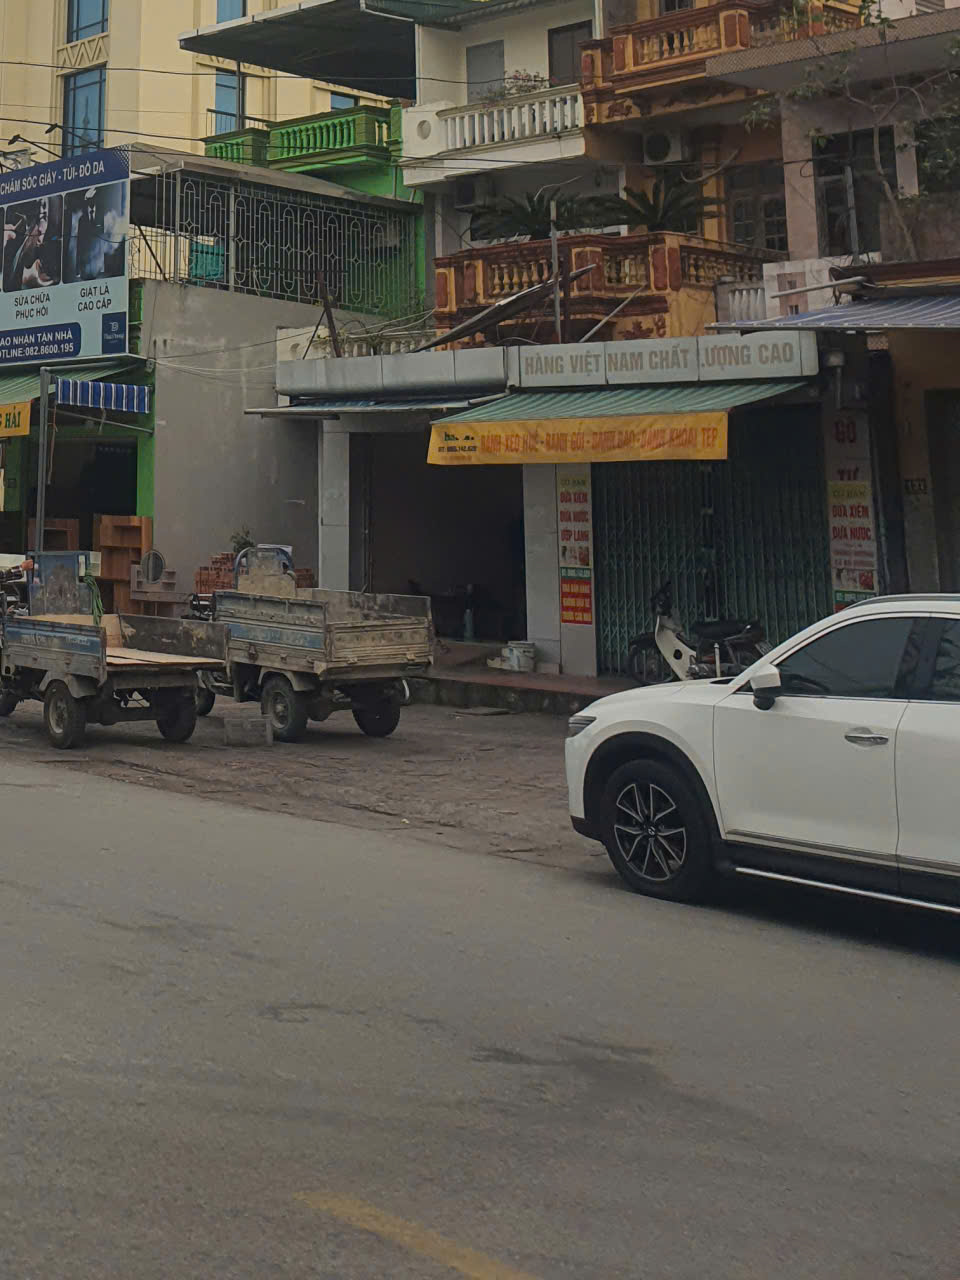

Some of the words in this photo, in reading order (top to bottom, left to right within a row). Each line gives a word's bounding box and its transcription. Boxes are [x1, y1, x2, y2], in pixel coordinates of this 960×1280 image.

[92, 160, 105, 174] DA
[78, 300, 95, 312] CAO
[524, 354, 564, 376] HÀNG
[607, 352, 644, 372] NAM
[648, 344, 690, 370] CHẤT
[701, 344, 752, 370] ƯỢNG
[757, 342, 794, 365] CAO
